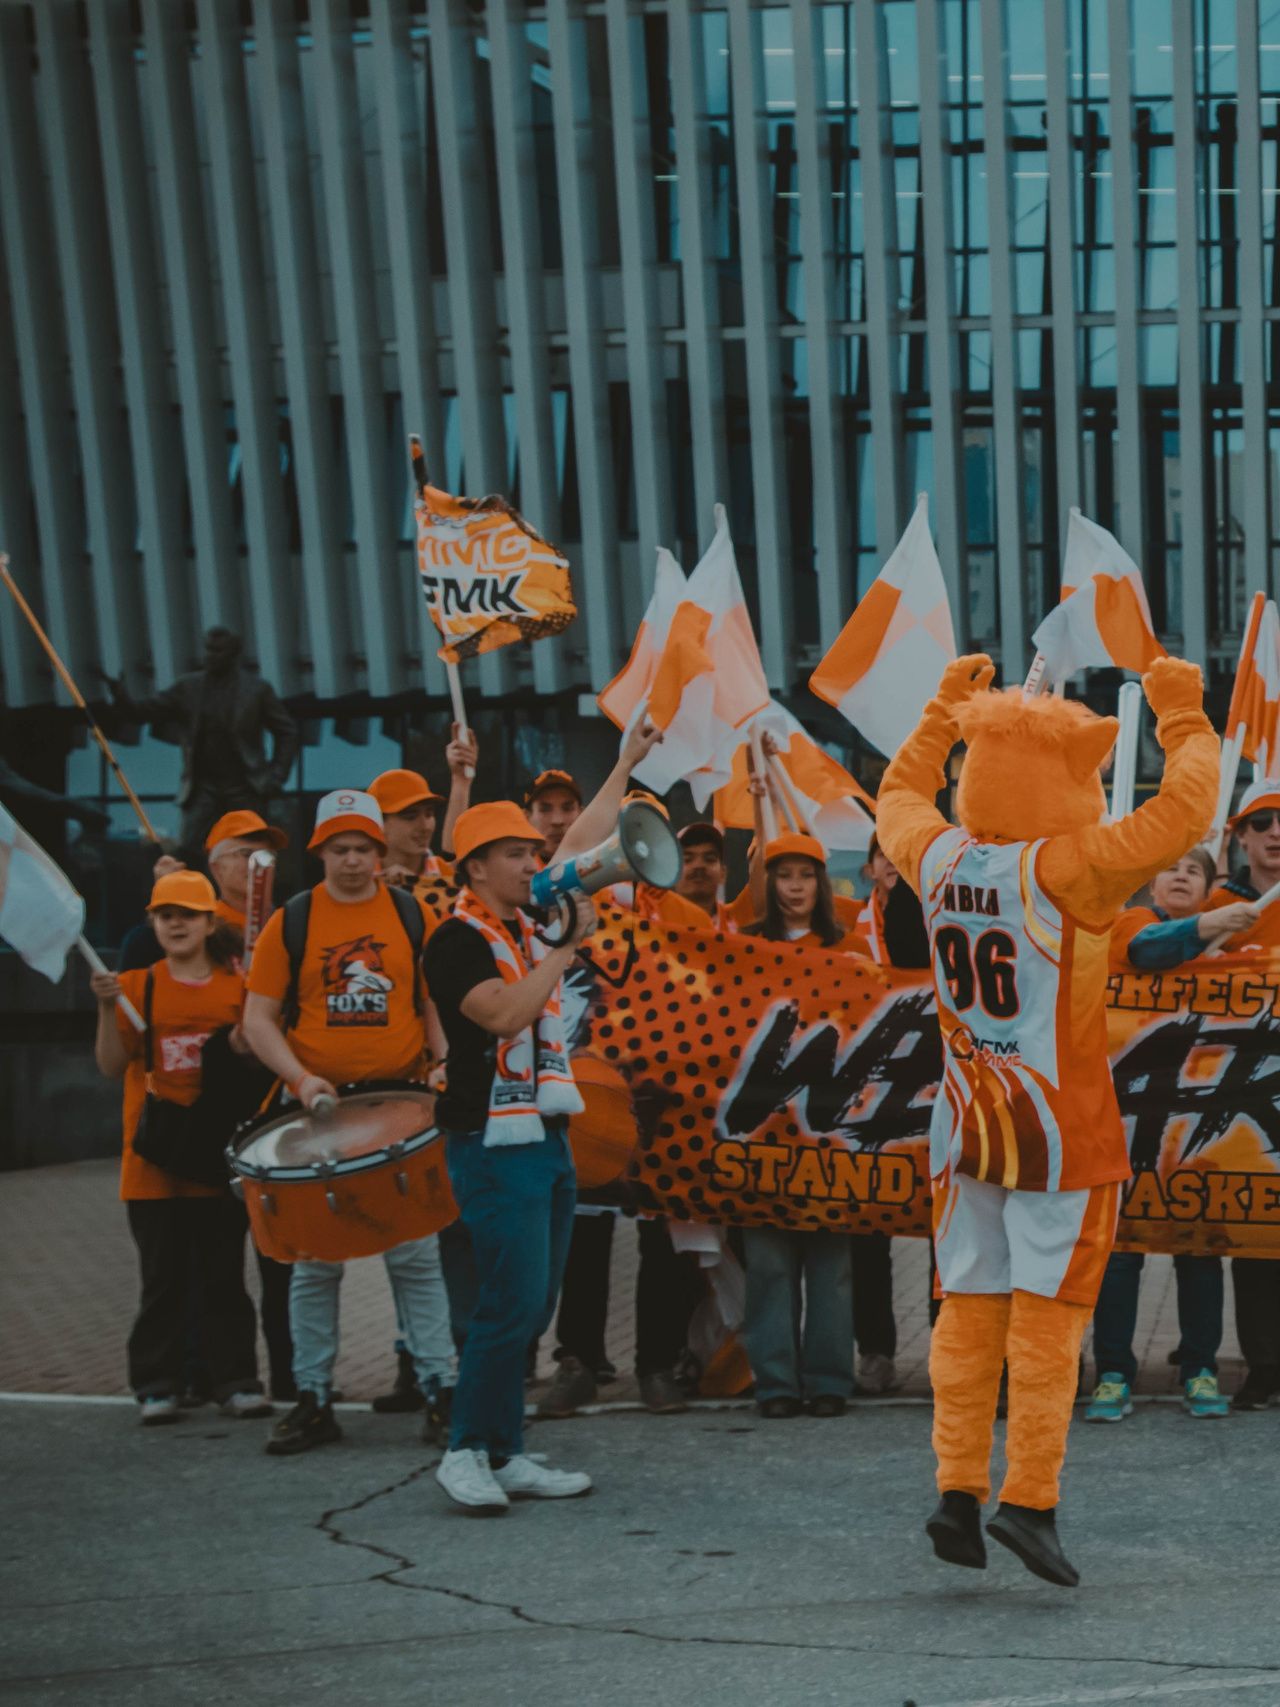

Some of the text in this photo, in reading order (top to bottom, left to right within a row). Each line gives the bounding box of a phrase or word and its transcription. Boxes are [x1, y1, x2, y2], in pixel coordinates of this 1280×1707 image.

[327, 993, 388, 1013] FOX'S
[934, 924, 1020, 1020] 96
[711, 1140, 917, 1208] STAND
